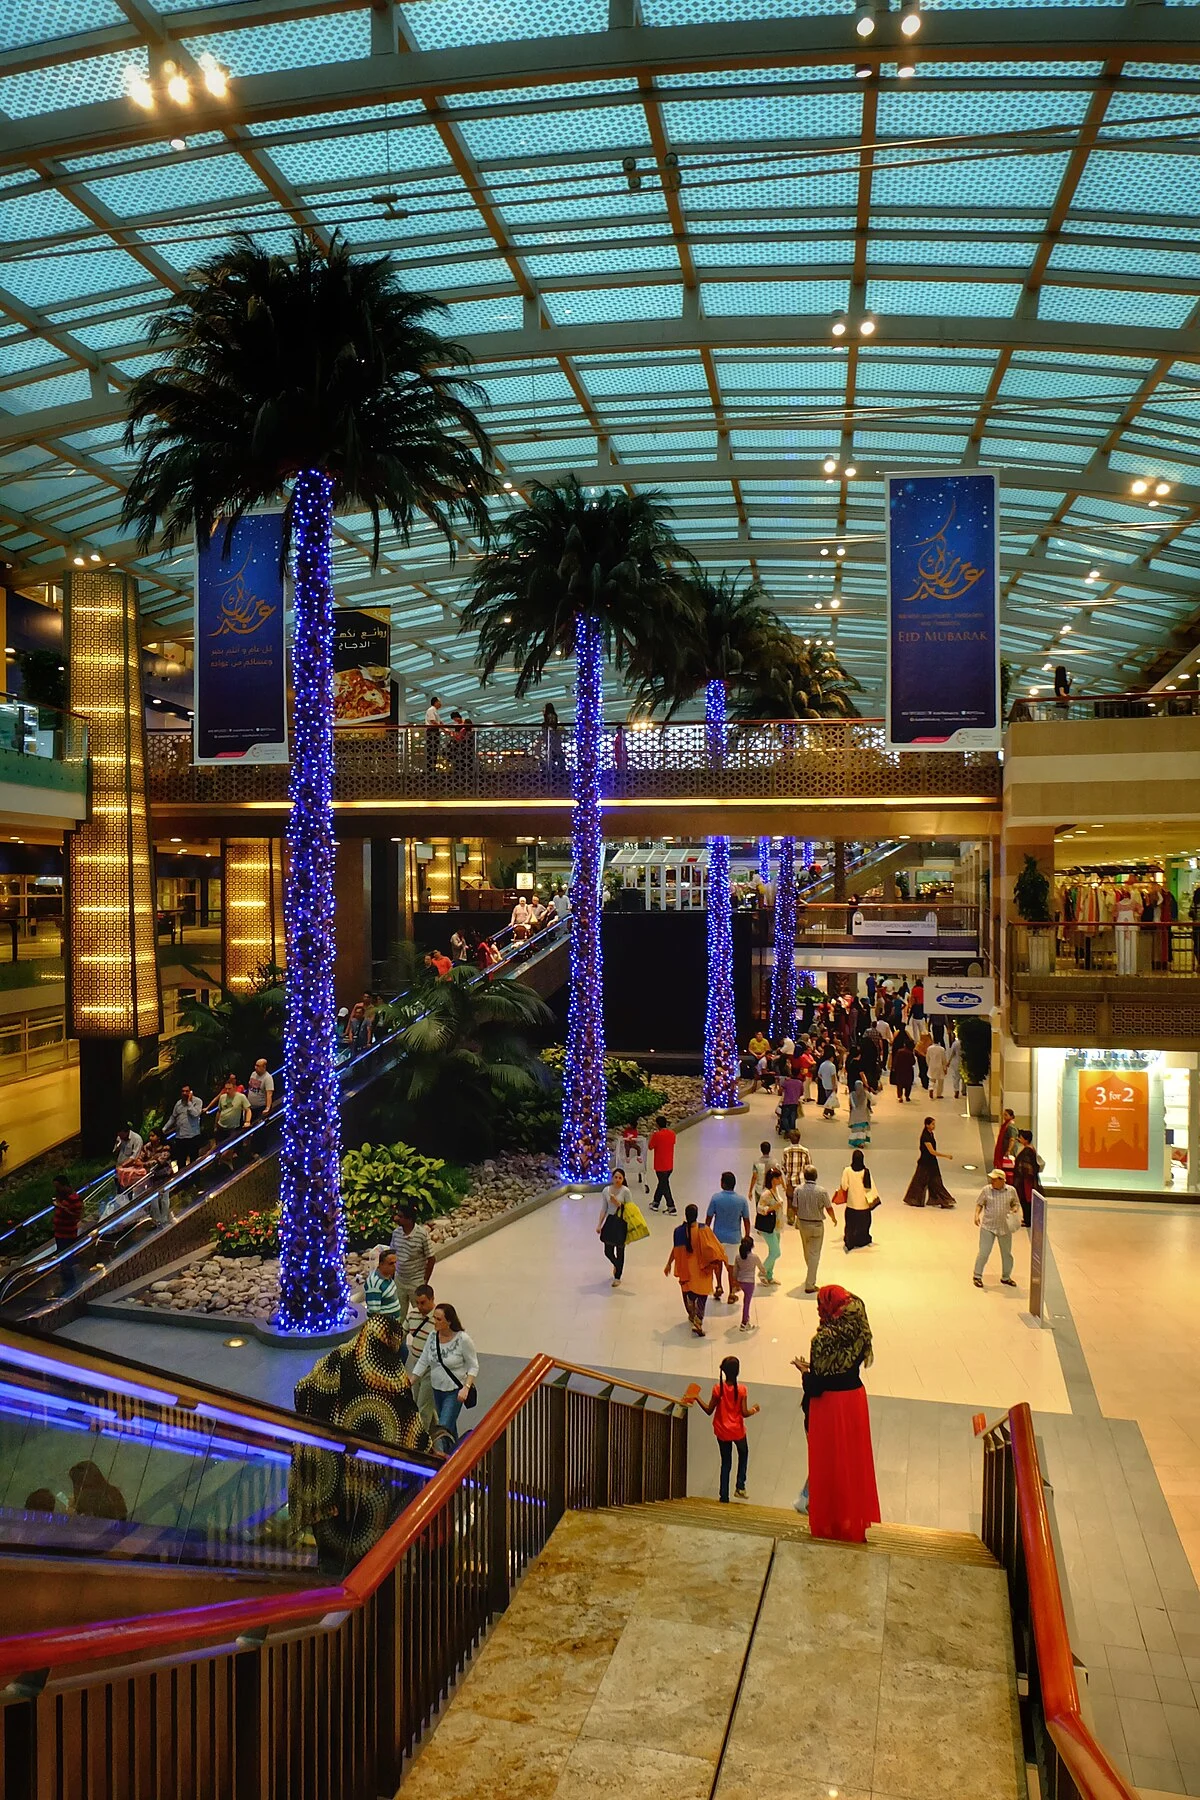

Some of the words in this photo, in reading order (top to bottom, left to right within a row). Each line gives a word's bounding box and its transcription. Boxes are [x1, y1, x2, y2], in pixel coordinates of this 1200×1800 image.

[332, 628, 356, 639] نكه
[361, 627, 387, 639] روائع
[898, 631, 920, 642] EID
[925, 631, 988, 643] MUBARAK
[338, 641, 370, 651] الدجاج
[1095, 1086, 1107, 1105] 3
[1109, 1091, 1122, 1101] for
[1122, 1087, 1134, 1103] 2
